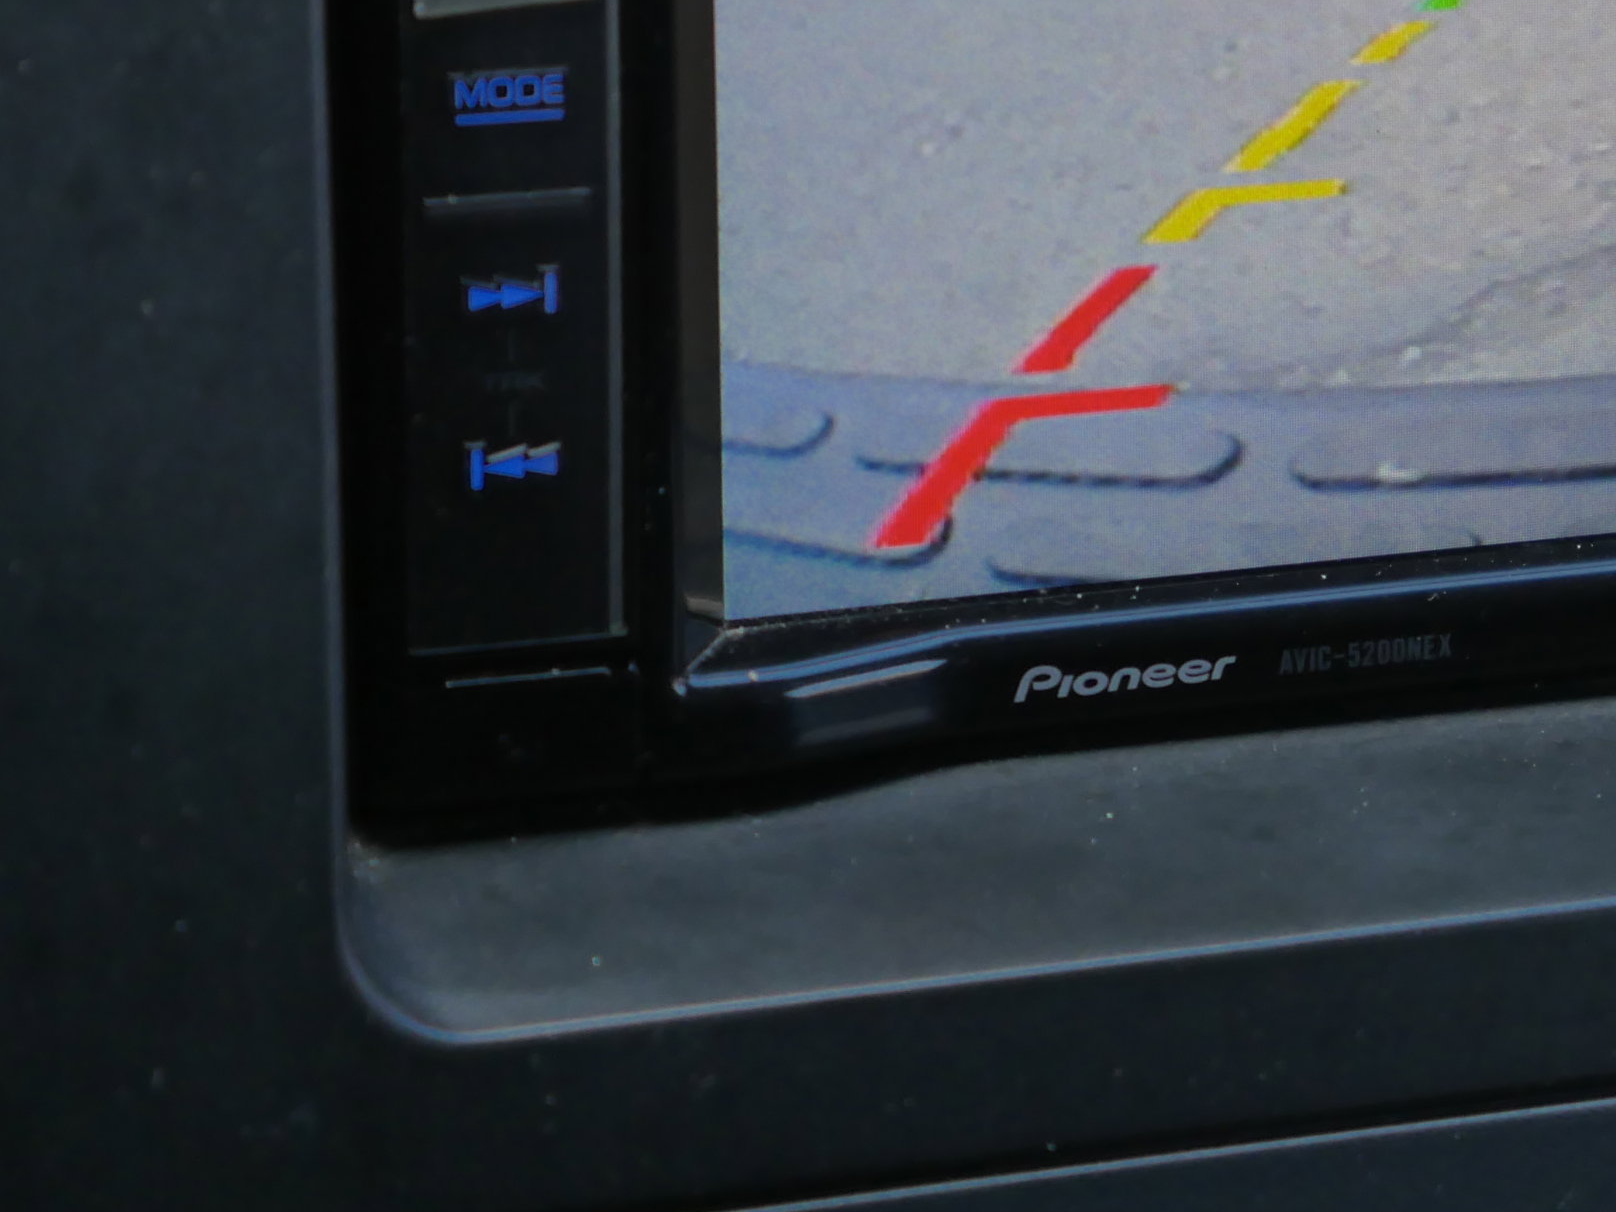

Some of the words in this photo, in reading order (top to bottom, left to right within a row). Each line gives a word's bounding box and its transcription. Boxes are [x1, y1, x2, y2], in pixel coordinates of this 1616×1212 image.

[453, 71, 566, 111] MODE
[1278, 633, 1453, 676] AVIC-5200NEX
[1013, 654, 1237, 704] Pioneer
